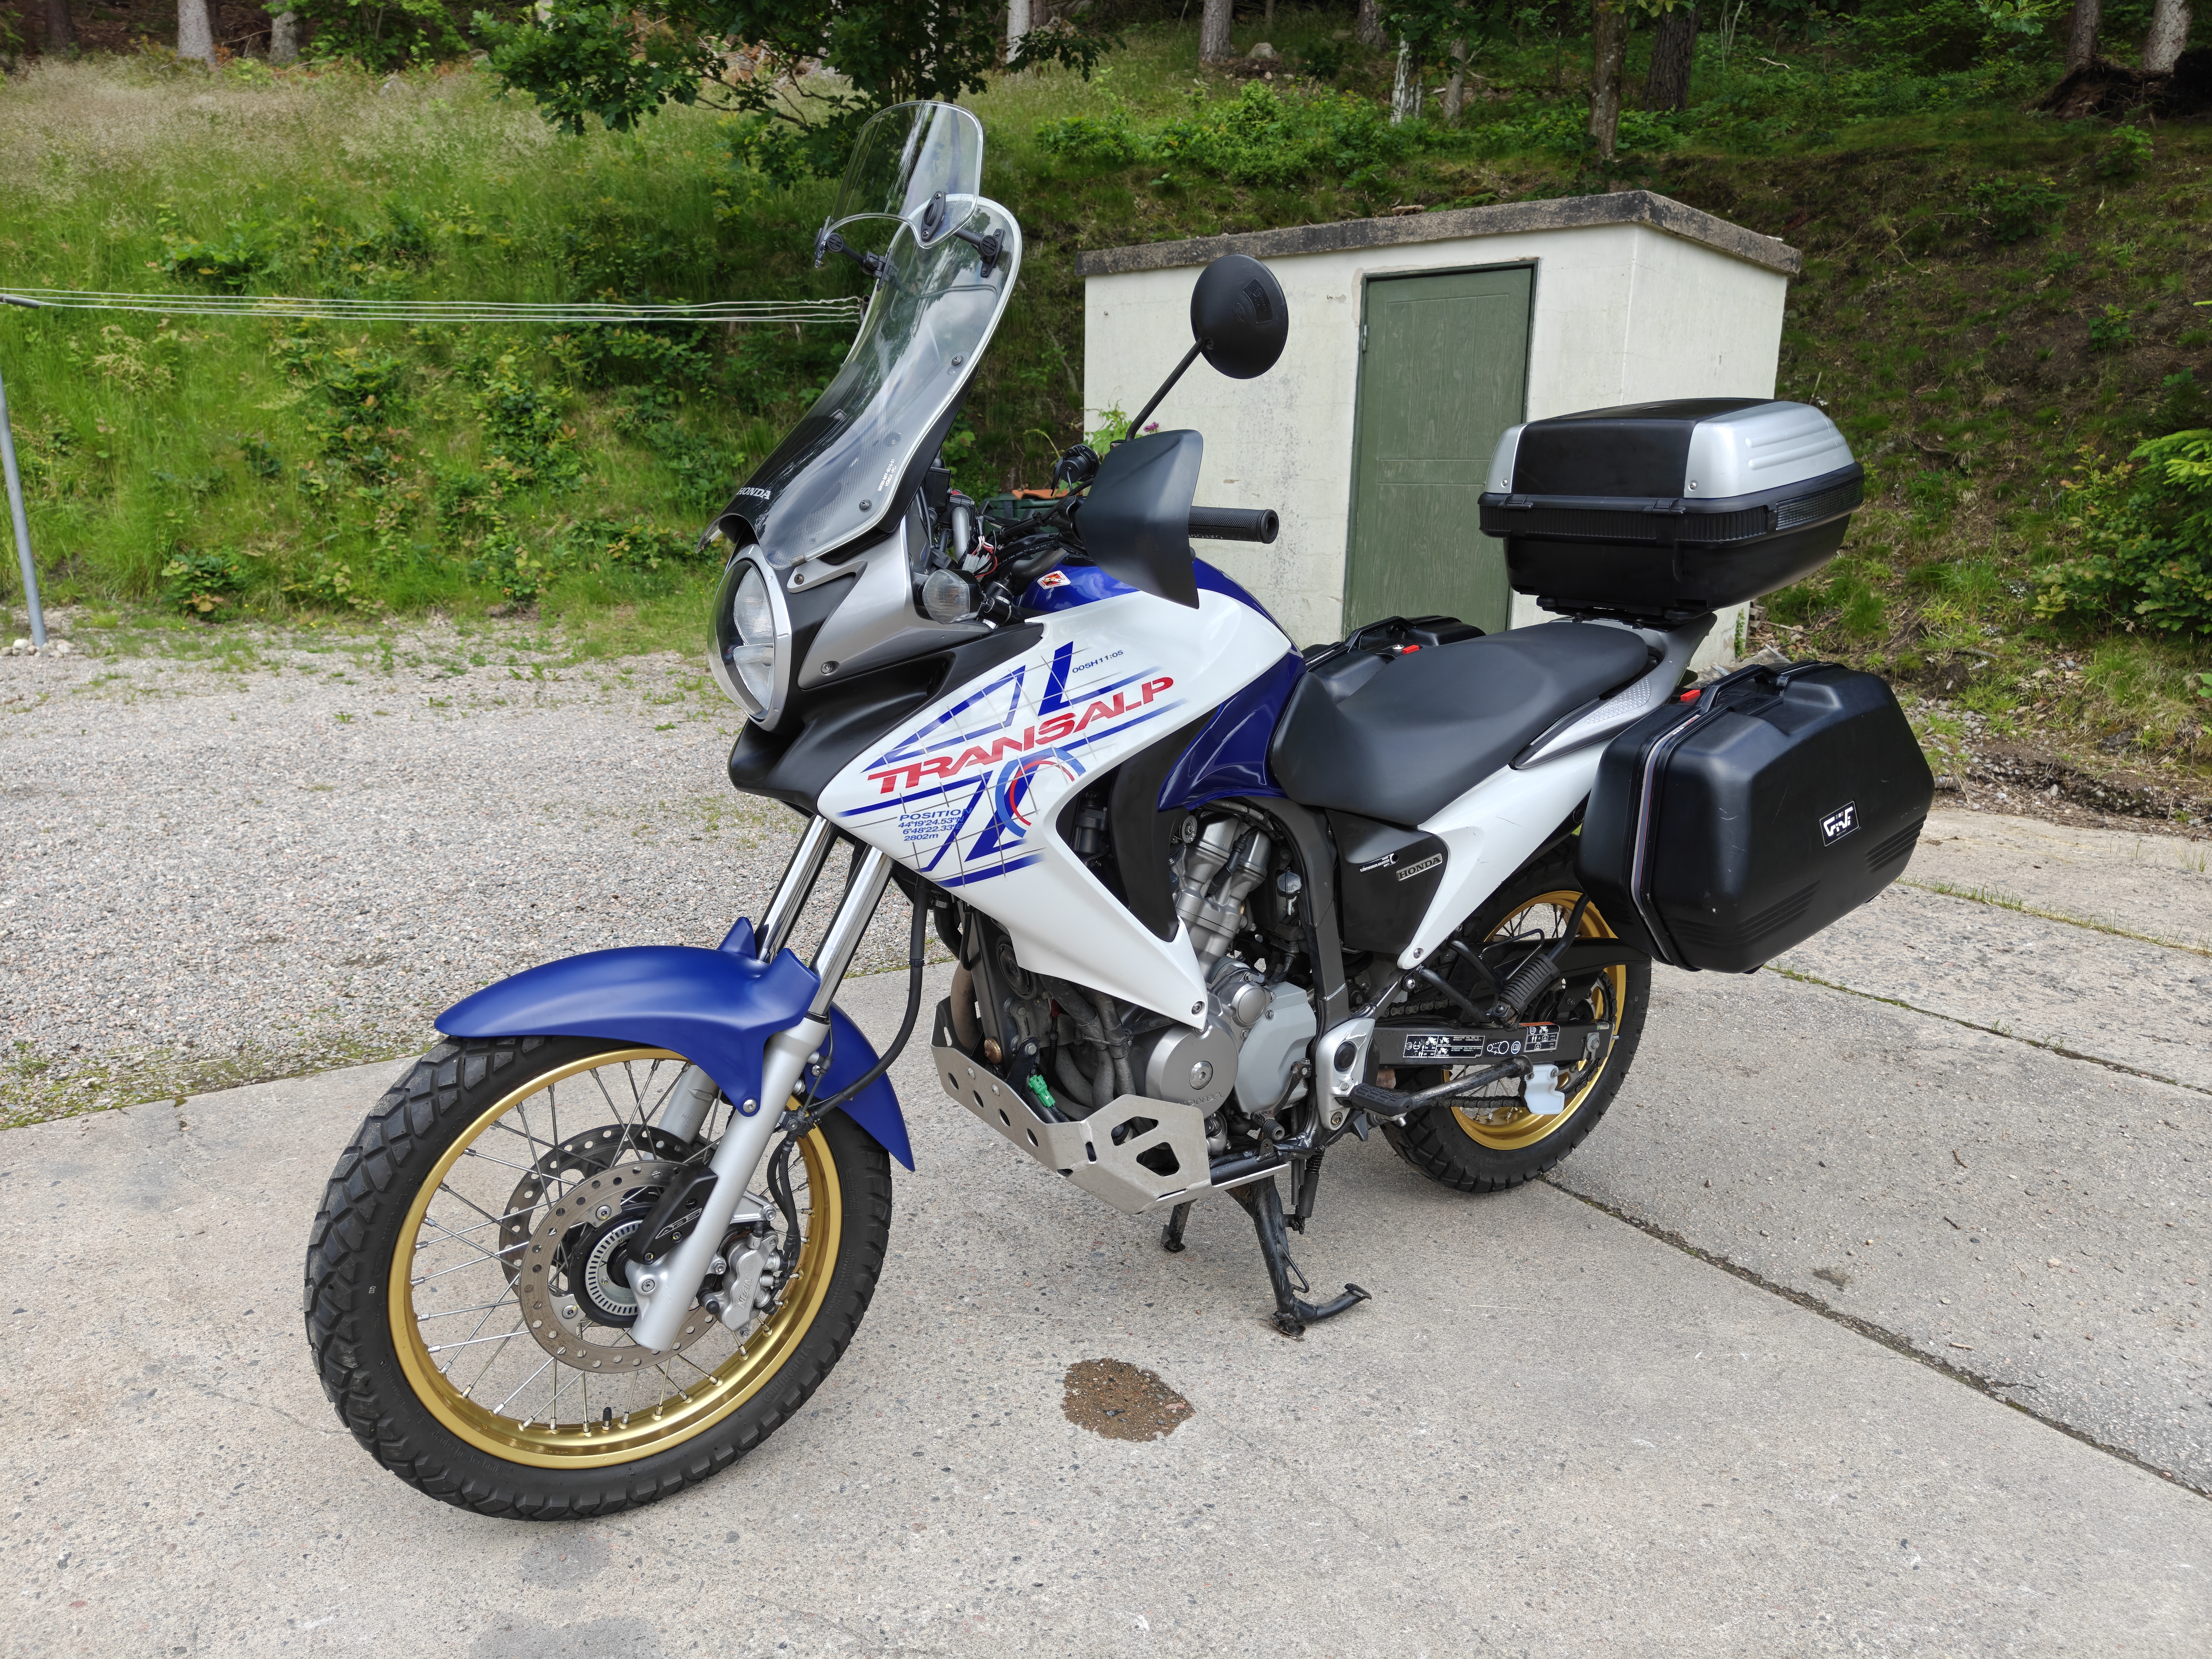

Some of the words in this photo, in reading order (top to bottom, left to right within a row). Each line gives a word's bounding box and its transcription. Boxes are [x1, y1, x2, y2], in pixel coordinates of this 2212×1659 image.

[885, 474, 893, 486] HONDA
[736, 487, 771, 500] HONDA
[1072, 650, 1123, 673] 005H11:05
[867, 677, 1174, 794] TRANSALP
[900, 808, 972, 821] POSITION
[1399, 857, 1441, 879] HONDA
[1179, 1092, 1224, 1106] ONDA
[655, 1208, 702, 1239] ABS
[738, 1274, 752, 1309] NISSIN
